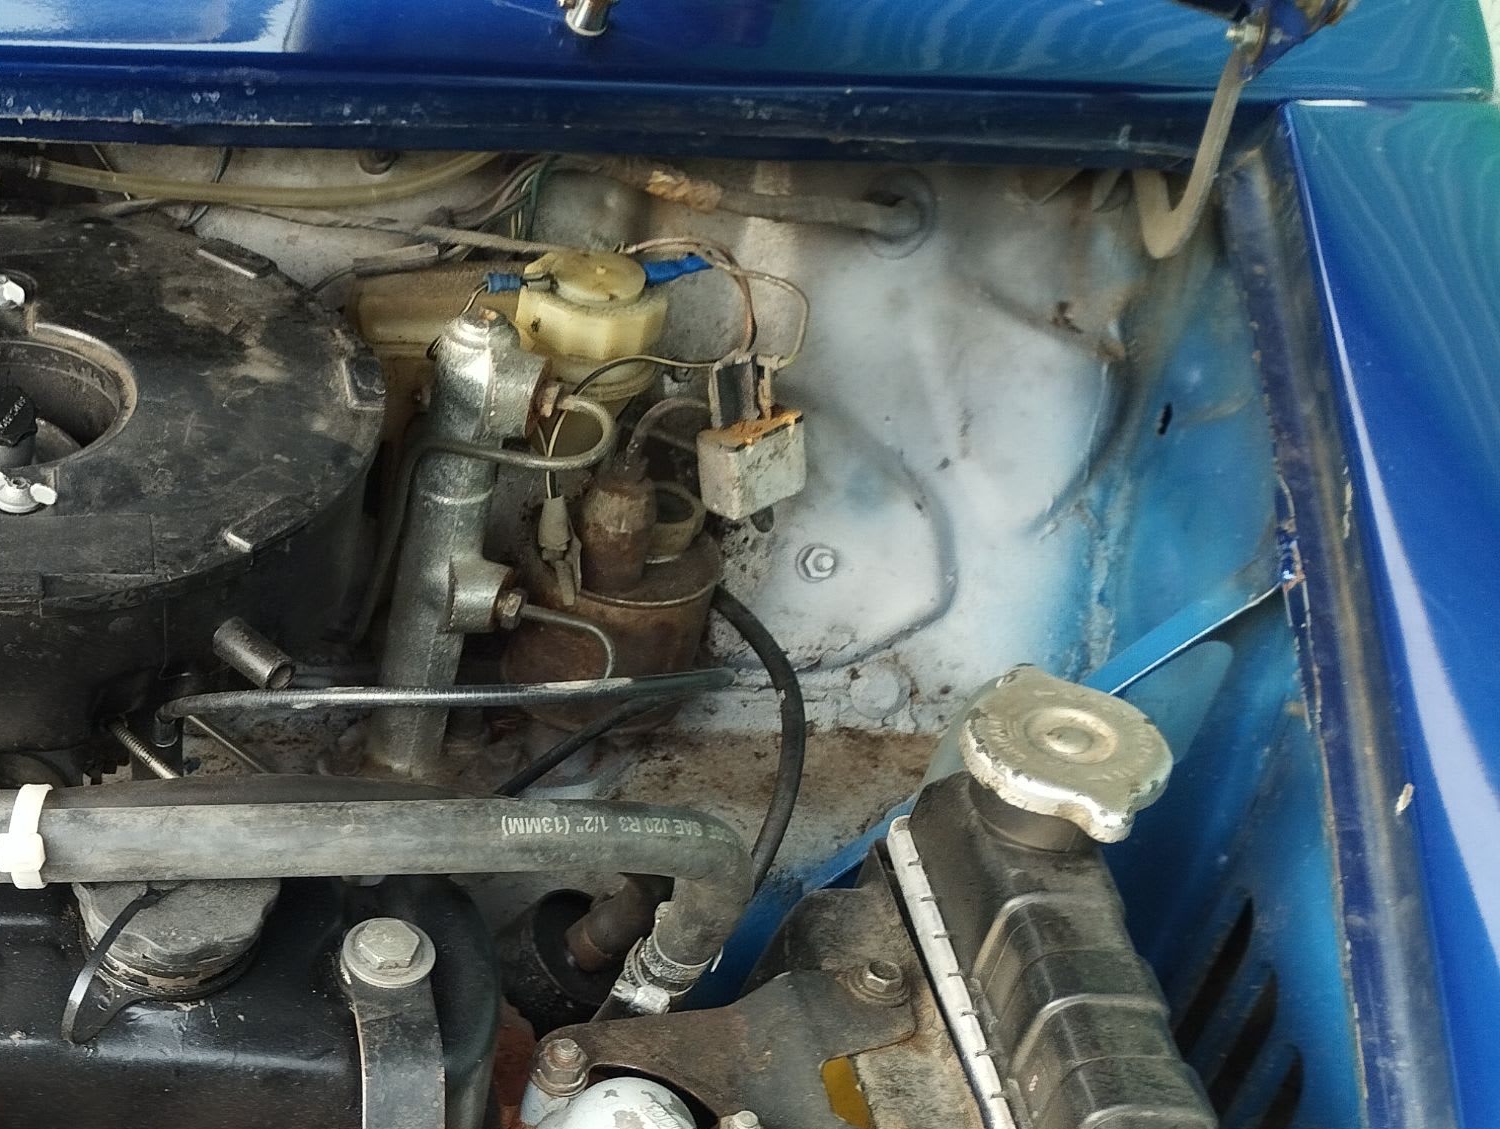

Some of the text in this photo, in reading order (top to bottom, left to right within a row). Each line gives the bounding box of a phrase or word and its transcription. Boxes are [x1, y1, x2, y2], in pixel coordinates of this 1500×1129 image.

[501, 813, 570, 836] (13MM)
[619, 815, 641, 833] R3
[645, 816, 671, 834] J20
[673, 818, 703, 837] SAE
